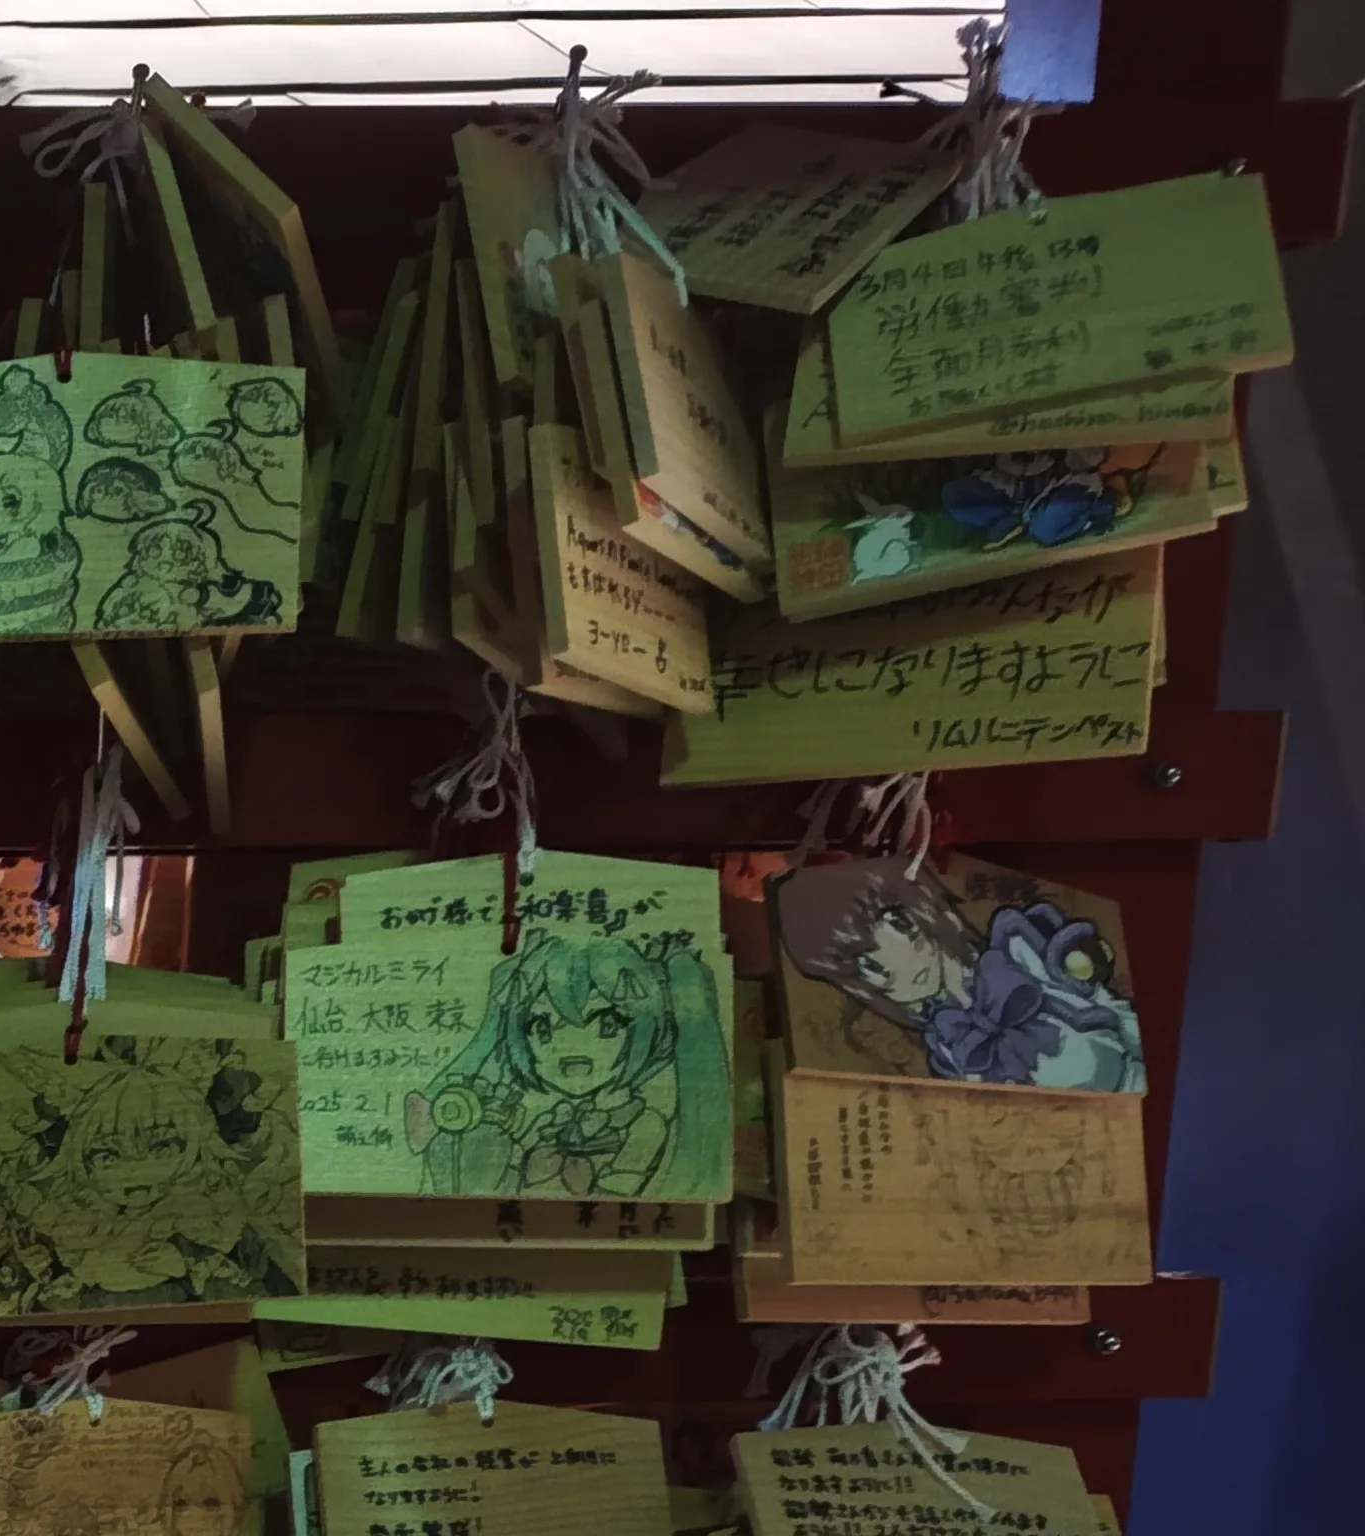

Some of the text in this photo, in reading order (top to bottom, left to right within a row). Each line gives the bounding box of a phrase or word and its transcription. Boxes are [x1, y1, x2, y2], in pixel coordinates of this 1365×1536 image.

[710, 639, 1151, 720] 幸せになりますように
[300, 956, 451, 988] マジカルミライ
